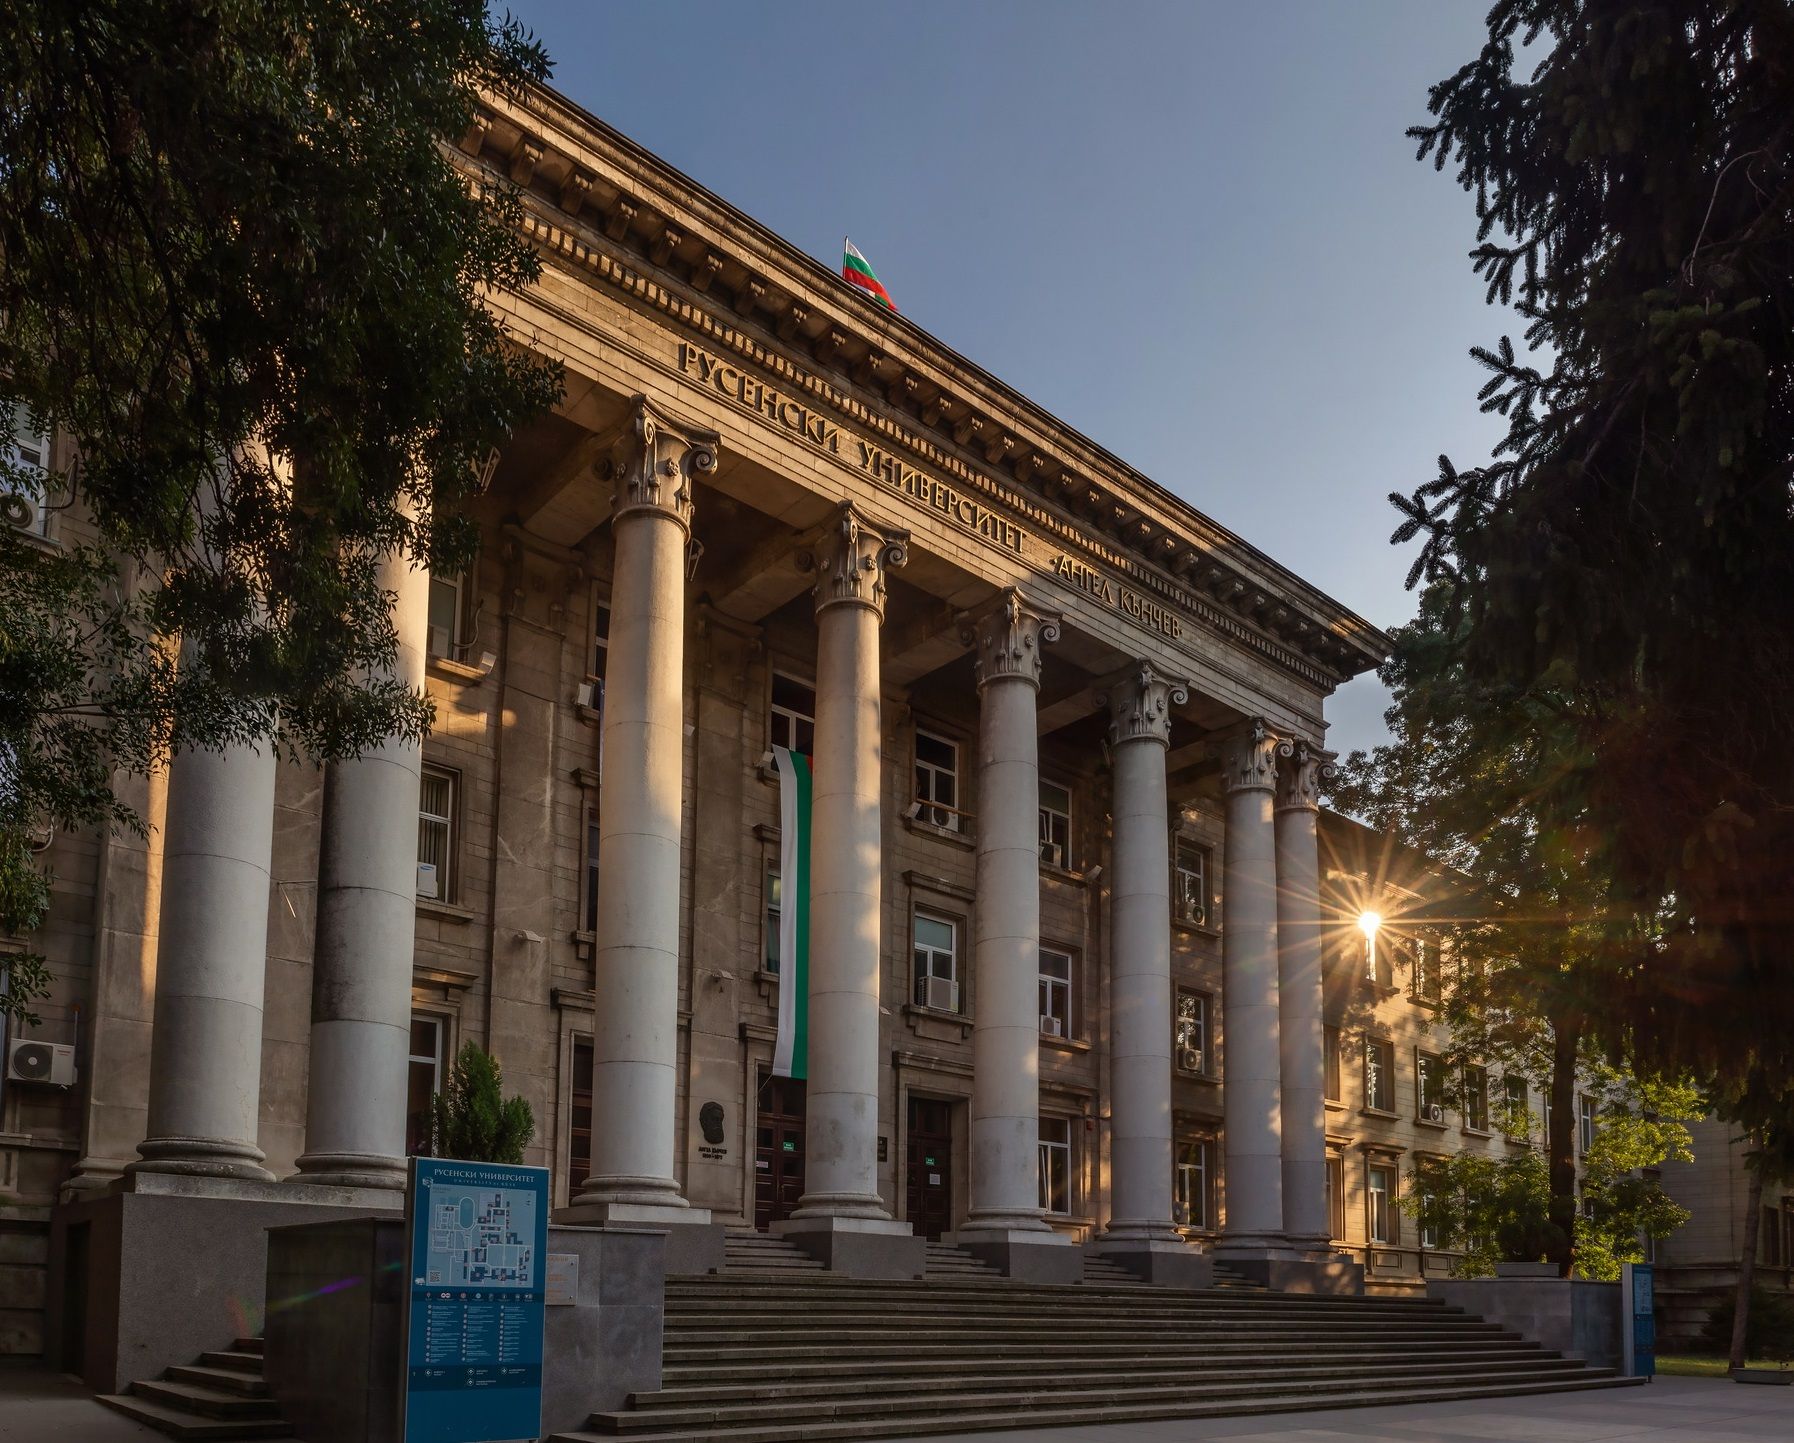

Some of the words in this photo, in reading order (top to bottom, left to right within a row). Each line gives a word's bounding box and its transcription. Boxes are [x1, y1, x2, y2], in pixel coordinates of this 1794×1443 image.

[678, 343, 839, 453] РУСЕНСКИ
[857, 441, 1026, 553] УНИВЕРСИТЕТ
[434, 1168, 477, 1178] РУСЕНСКИ
[479, 1171, 535, 1183] УНИВЕРСИТЕТ
